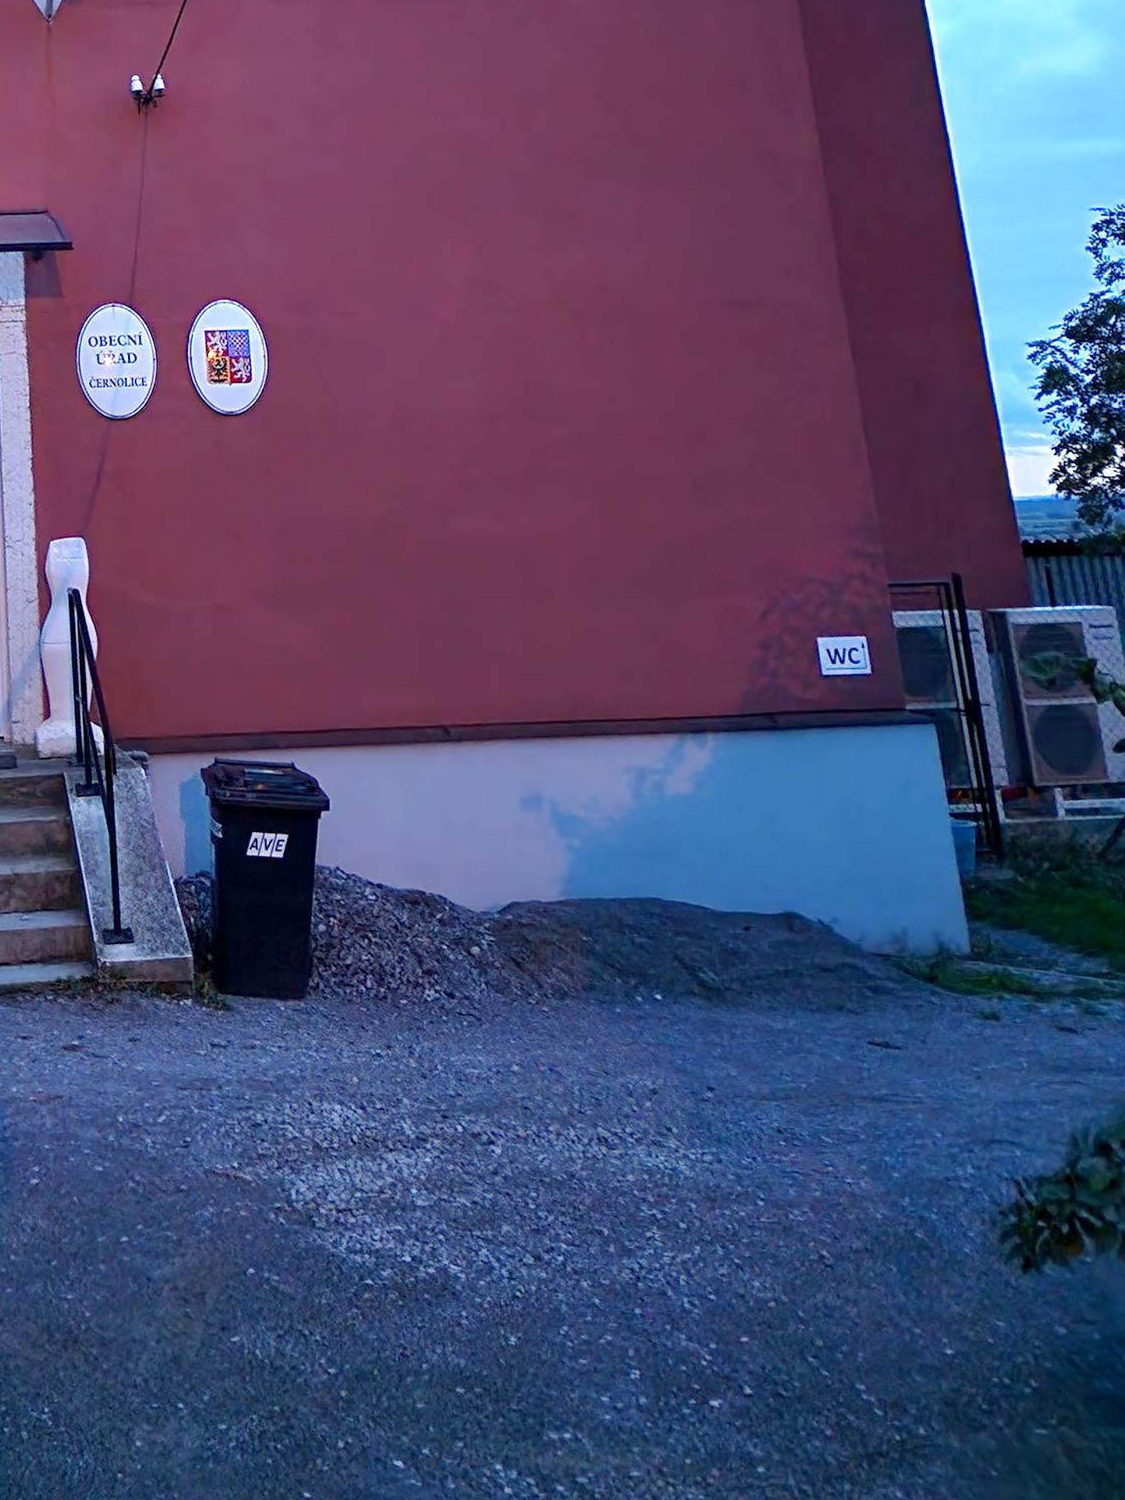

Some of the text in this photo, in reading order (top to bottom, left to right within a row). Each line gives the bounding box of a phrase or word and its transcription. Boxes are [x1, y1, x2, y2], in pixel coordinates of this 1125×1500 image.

[88, 331, 143, 348] OBECNÍ
[89, 376, 148, 389] ČERNOLICE
[826, 647, 861, 665] WC
[249, 838, 286, 853] AVE
